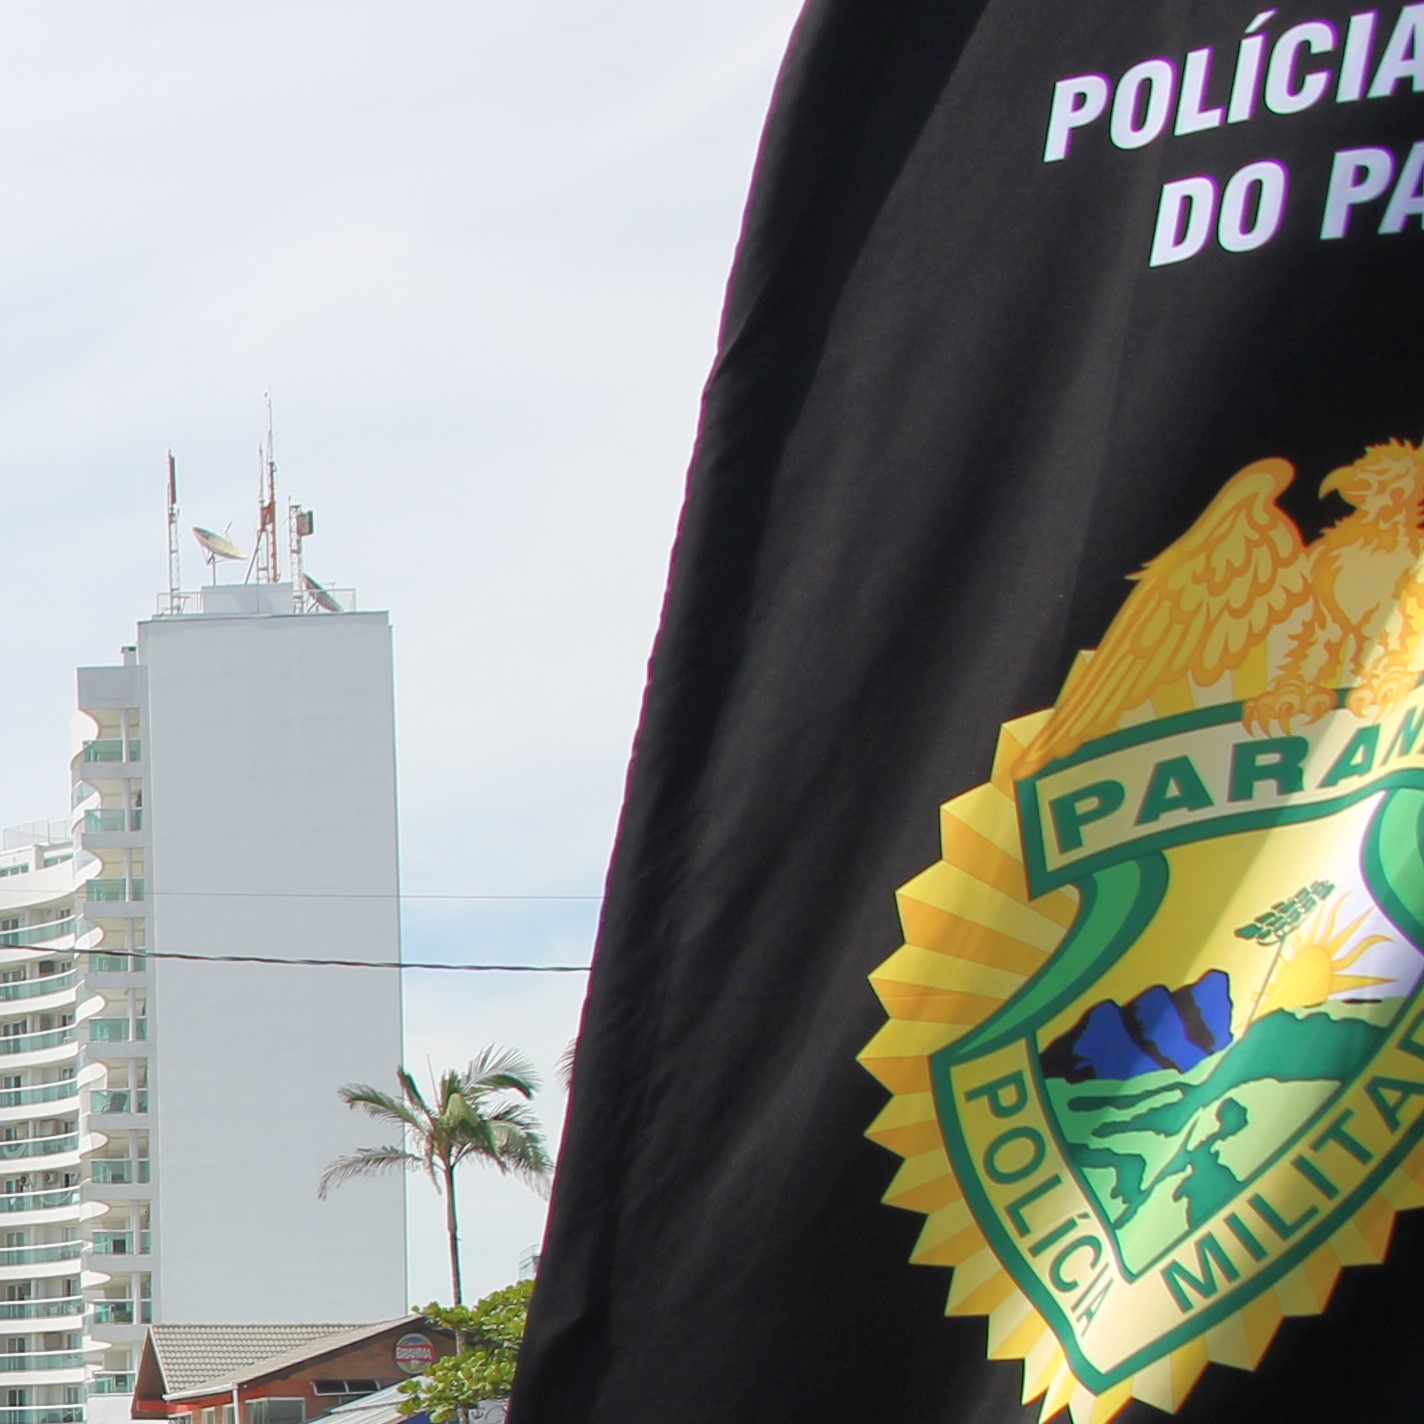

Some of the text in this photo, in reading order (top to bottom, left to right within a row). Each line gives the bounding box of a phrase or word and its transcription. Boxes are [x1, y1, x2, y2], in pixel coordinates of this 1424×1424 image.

[1042, 2, 1424, 163] POLÍCIA
[1149, 140, 1424, 267] DO PA
[1049, 706, 1424, 855] PARAN
